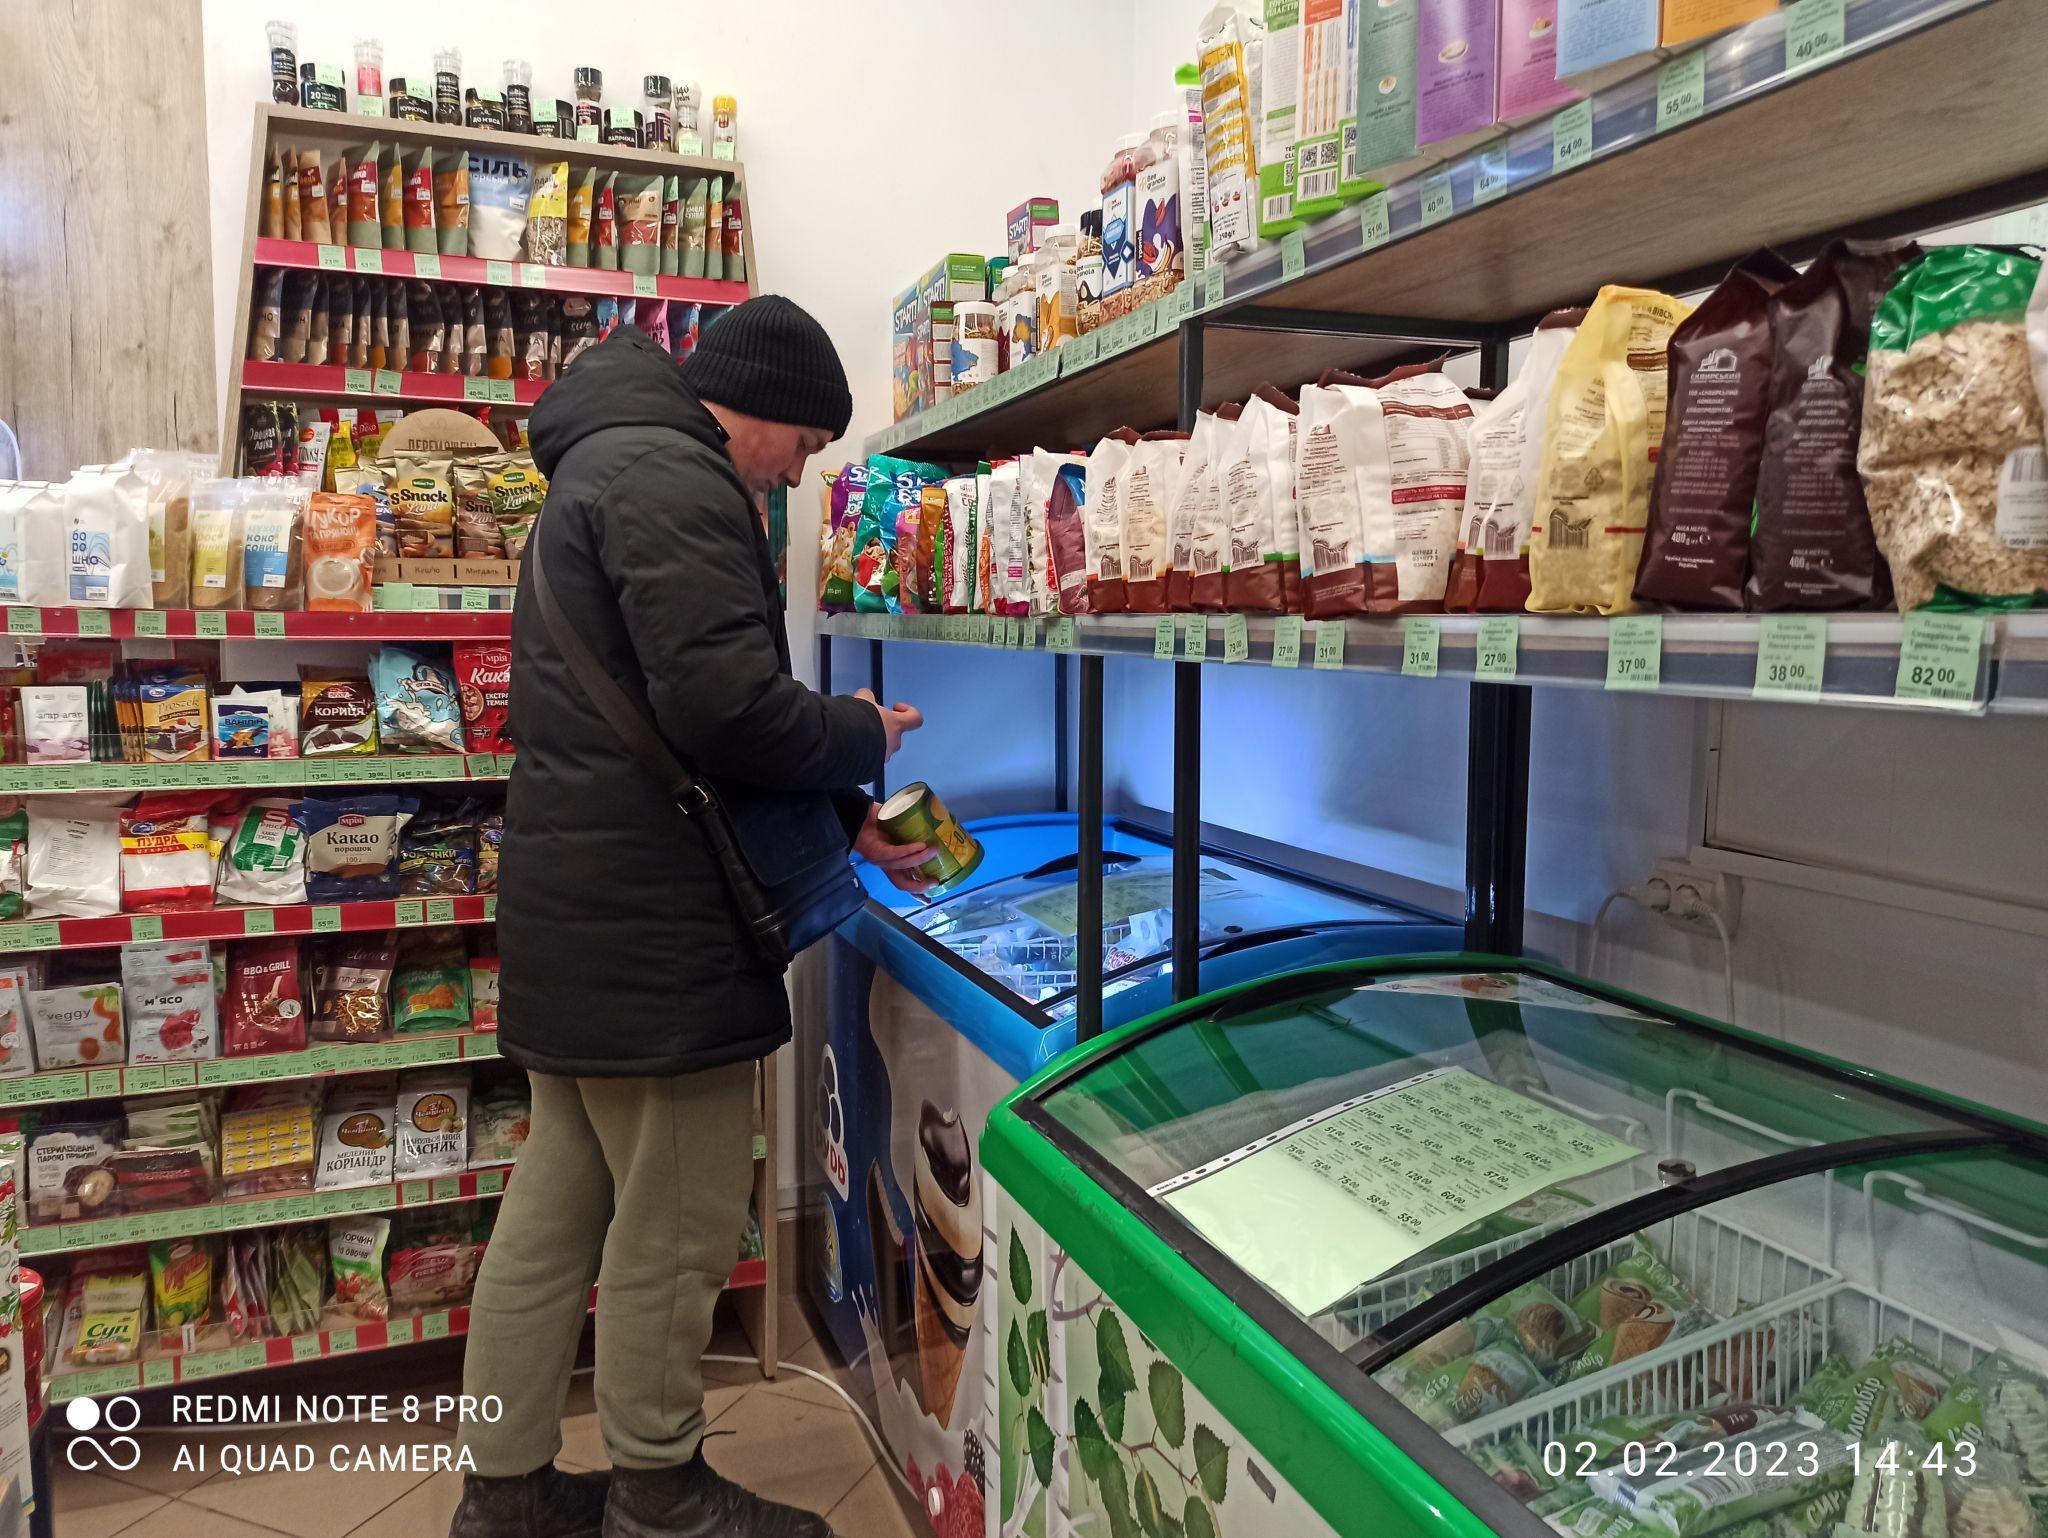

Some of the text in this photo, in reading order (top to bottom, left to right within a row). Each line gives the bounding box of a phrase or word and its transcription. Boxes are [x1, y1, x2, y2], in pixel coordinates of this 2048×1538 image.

[1796, 32, 1828, 57] 40 00
[1666, 92, 1691, 114] 55 00
[400, 106, 428, 114] КУРКУМА
[1560, 138, 1582, 158] 64 00
[1147, 176, 1166, 190] granola
[1480, 175, 1498, 190] 64 00
[1428, 196, 1444, 213] 40 00
[1368, 223, 1382, 238] 51 00
[400, 488, 448, 503] Snack
[494, 482, 540, 498] Snack
[1671, 532, 1686, 543] 400
[466, 567, 499, 576] Мигдаль
[10, 623, 25, 631] 170
[1279, 646, 1293, 656] 27 00
[1320, 646, 1336, 658] 31 00
[1410, 652, 1430, 664] 31 00
[1484, 653, 1506, 666] 27 00
[1618, 657, 1646, 673] 37 00
[471, 668, 510, 685] Кака
[1769, 664, 1805, 682] 38 00
[1912, 666, 1955, 686] 82 00
[314, 706, 365, 717] КОРИЦЯ
[136, 835, 180, 847] ПУДРА
[327, 832, 379, 845] Какао
[334, 846, 372, 854] порошок
[243, 966, 262, 976] BBQ
[269, 960, 290, 972] GRILL
[144, 996, 182, 1006] м'ясо
[46, 1008, 91, 1021] veggy
[1324, 1126, 1336, 1134] 51
[1350, 1140, 1364, 1148] 51
[326, 1156, 386, 1172] КОРІАНДР
[1484, 1171, 1499, 1180] 57
[1441, 1191, 1455, 1200] 60
[1398, 1213, 1412, 1223] 55
[87, 1323, 128, 1338] Суп
